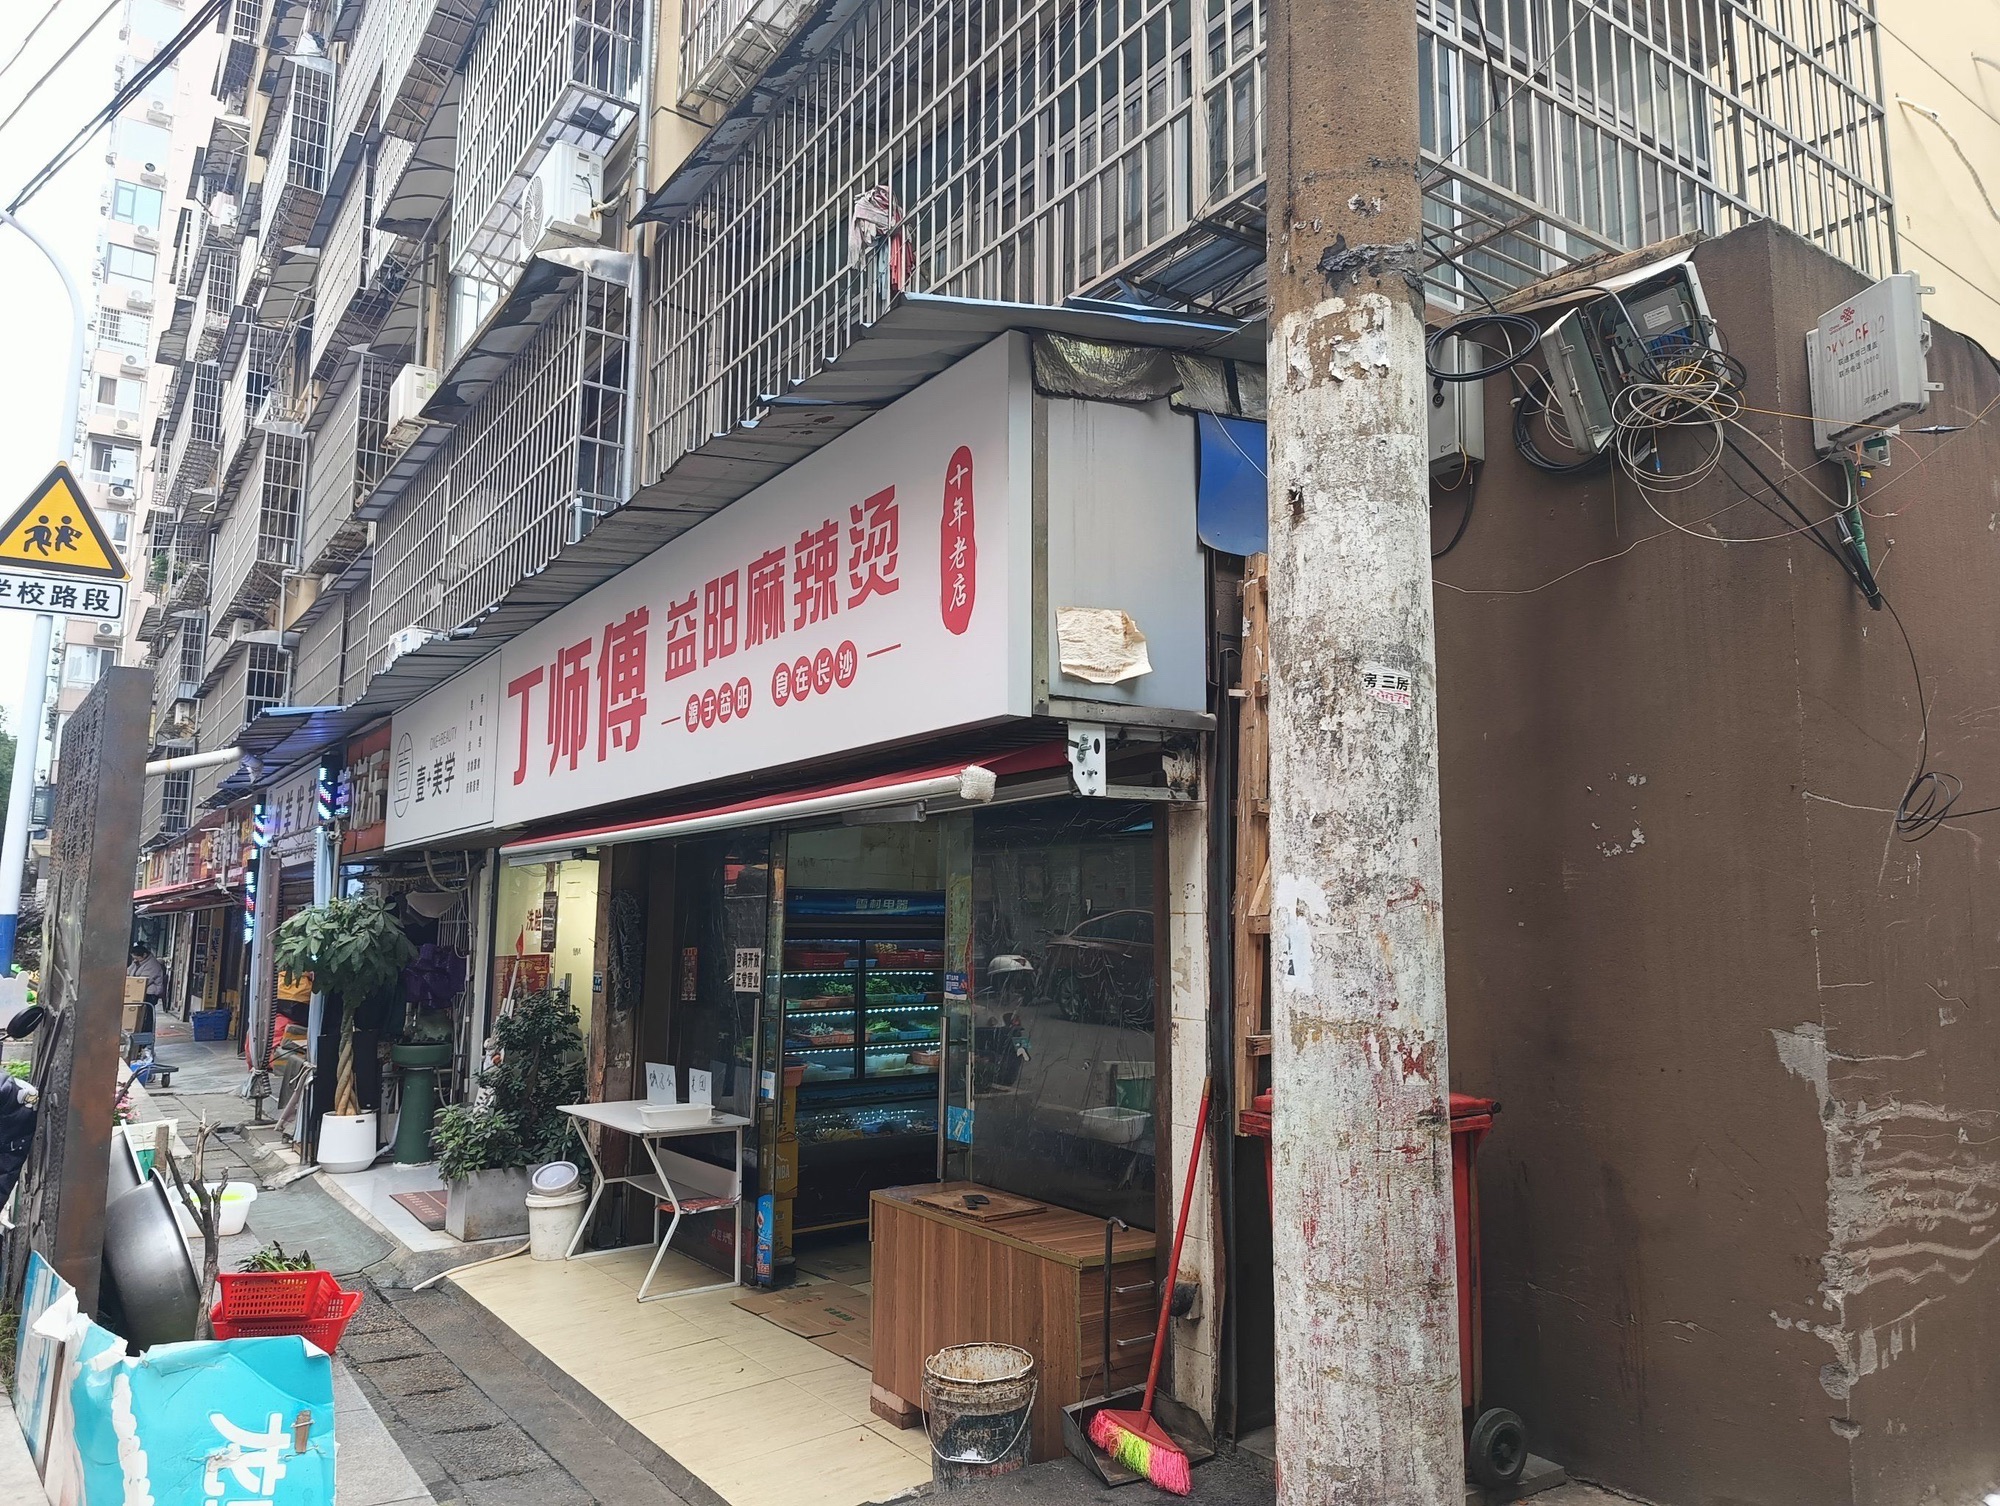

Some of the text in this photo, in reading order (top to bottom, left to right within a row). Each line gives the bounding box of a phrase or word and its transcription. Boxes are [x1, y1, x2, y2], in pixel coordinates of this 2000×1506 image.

[948, 463, 969, 612] 十年老店
[508, 605, 649, 786] 丁师傅
[665, 484, 899, 682] 益阳麻辣烫
[686, 648, 855, 727] 源于益阳 食在长沙
[415, 751, 456, 803] 壹+美学
[855, 897, 909, 910] 雪村电器
[735, 951, 760, 968] 空调开放
[735, 971, 759, 988] 正常营业
[204, 1411, 291, 1506] 龙
